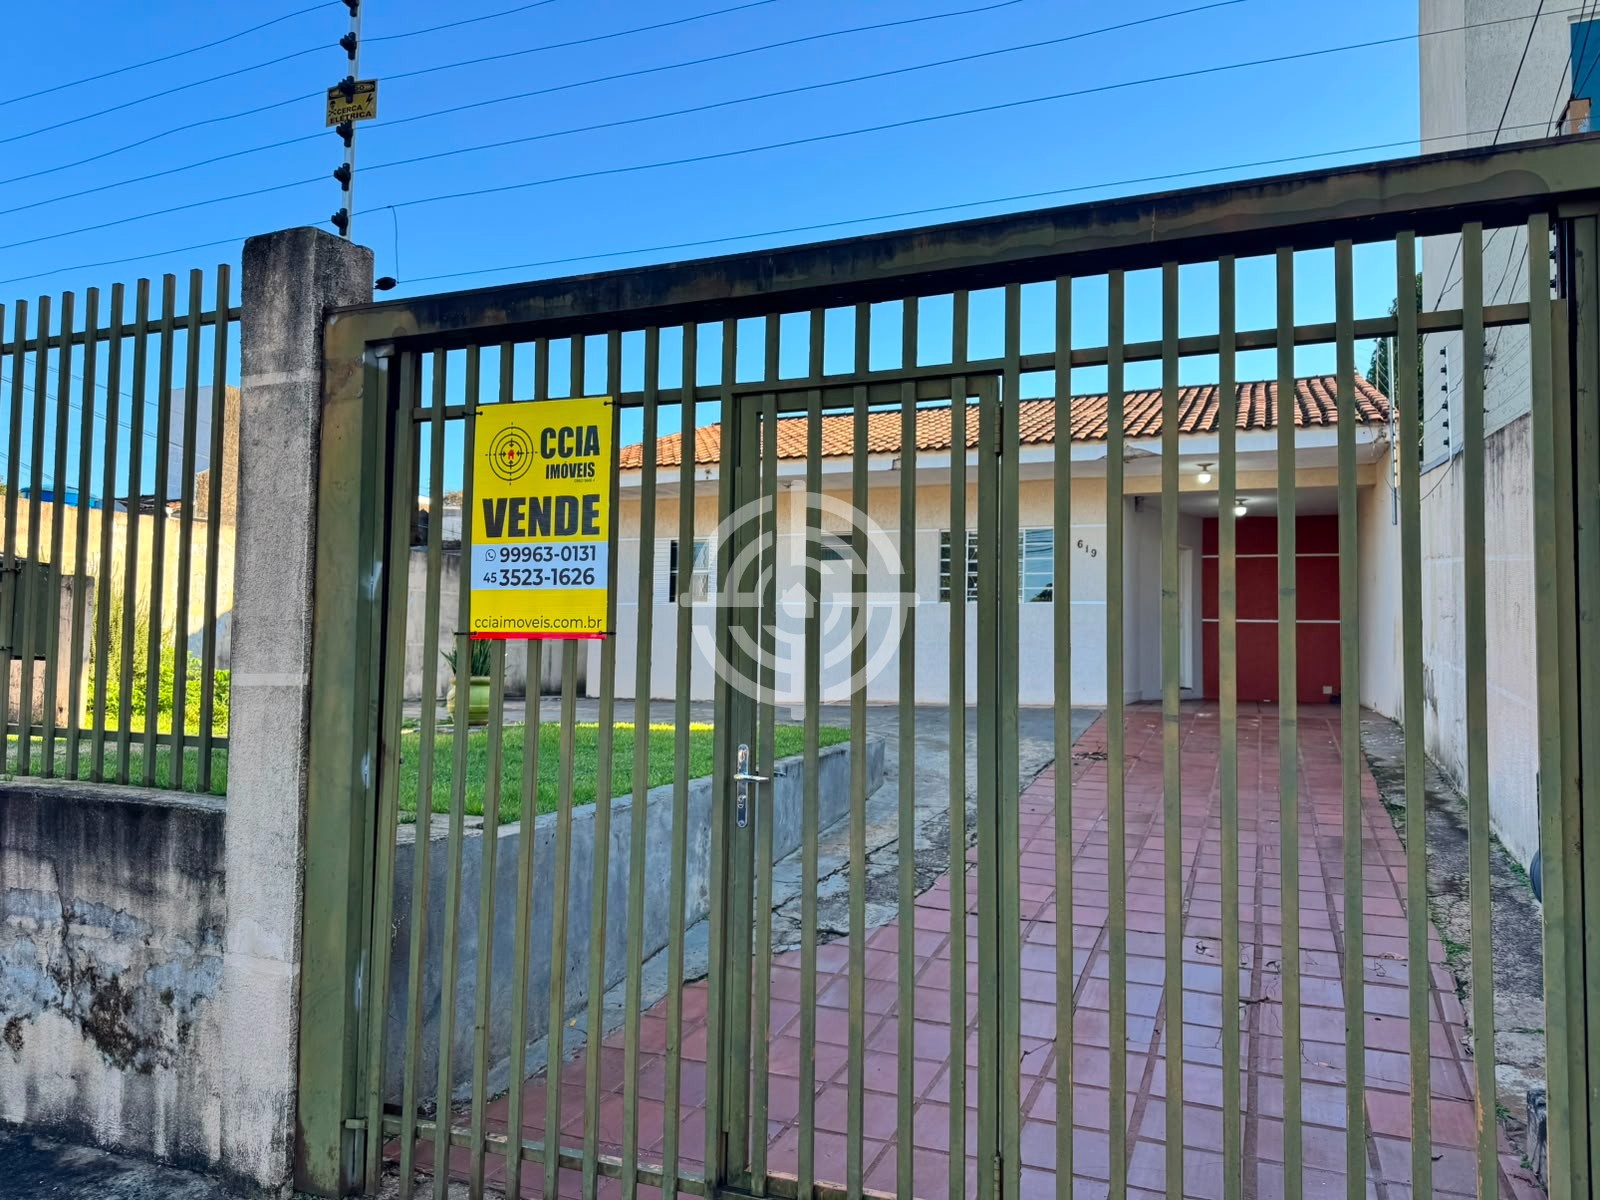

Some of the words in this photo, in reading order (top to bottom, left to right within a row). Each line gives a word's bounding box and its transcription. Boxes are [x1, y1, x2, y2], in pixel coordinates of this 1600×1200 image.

[337, 104, 363, 115] CERCA
[540, 425, 601, 460] CCIA
[545, 461, 596, 480] IMÓVEIS
[481, 493, 601, 539] VENDE
[499, 545, 596, 563] 99963-0131
[1077, 539, 1097, 558] 619
[482, 571, 497, 584] 45
[499, 567, 596, 587] 3523-1626
[474, 615, 603, 629] cciaimoveis.com.br
